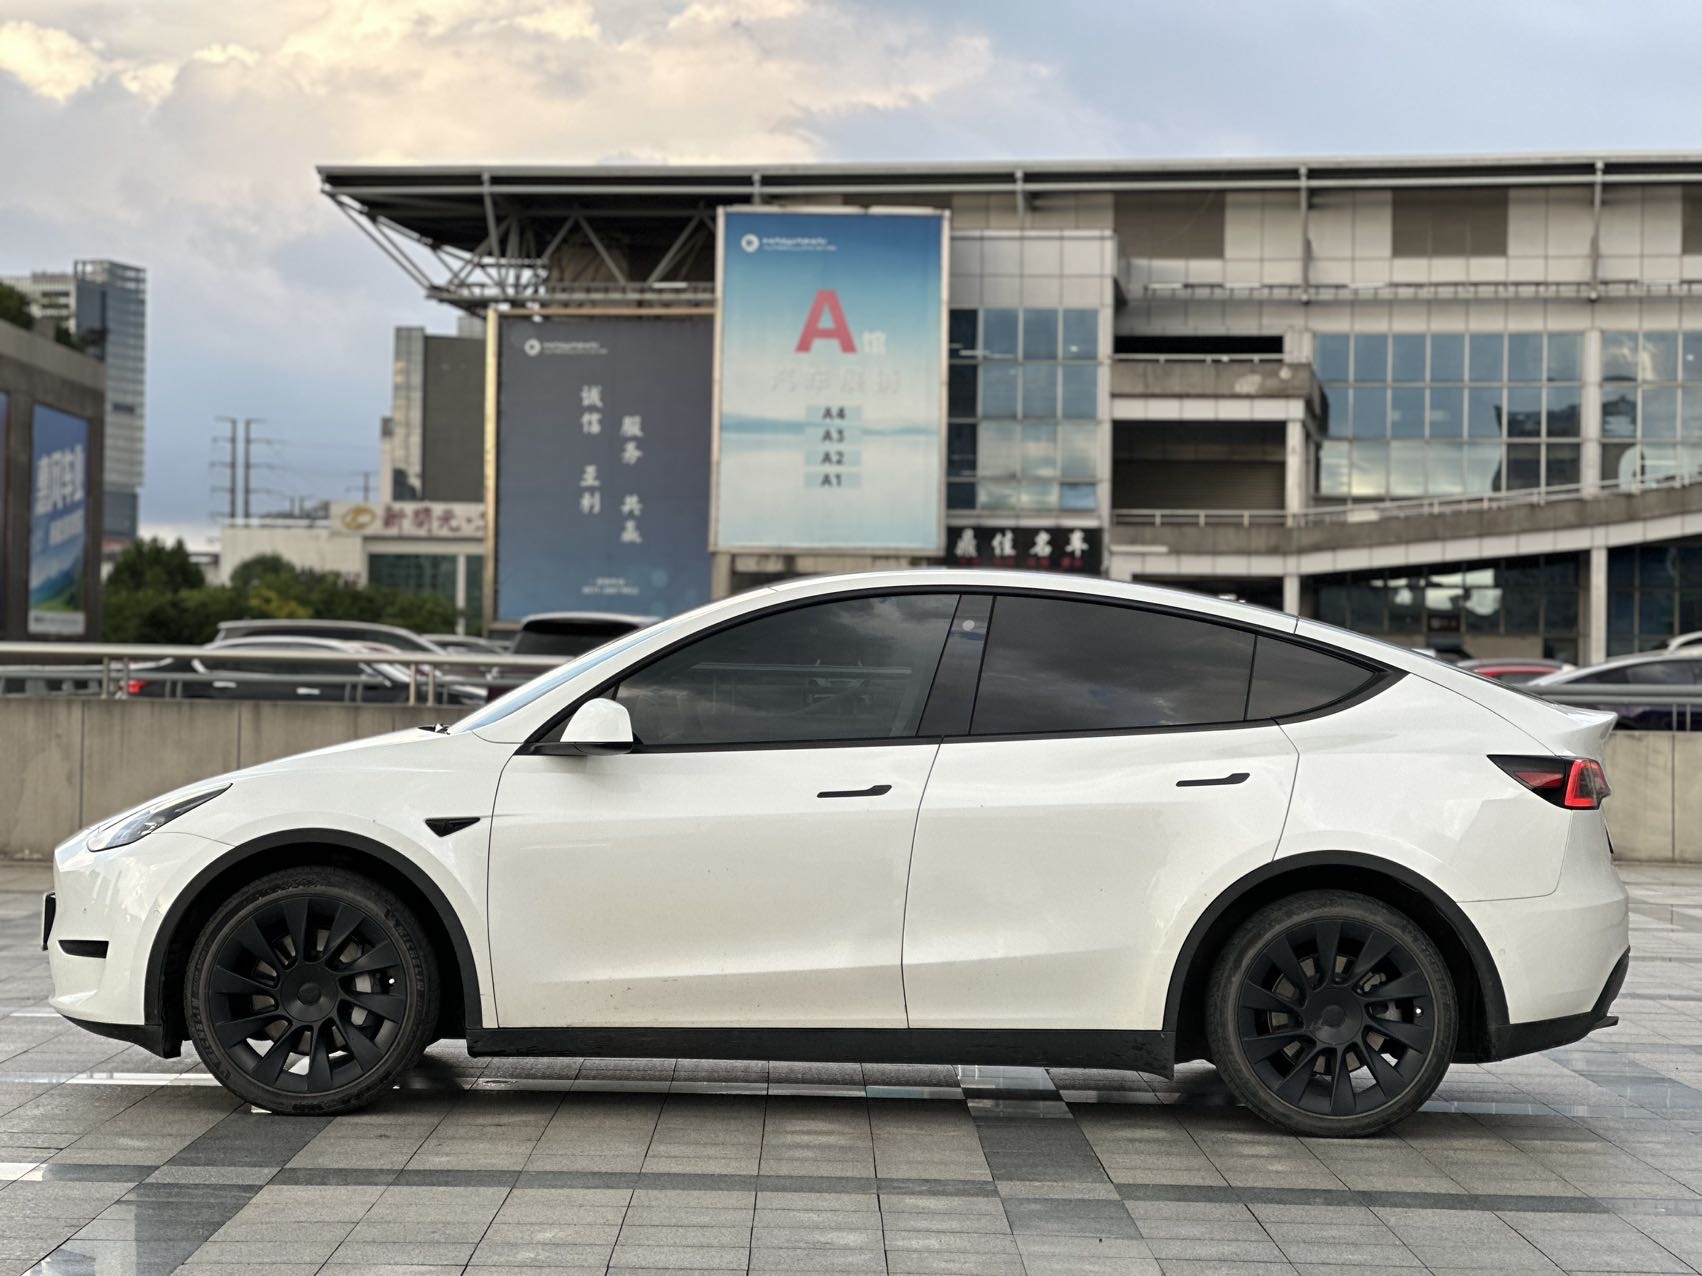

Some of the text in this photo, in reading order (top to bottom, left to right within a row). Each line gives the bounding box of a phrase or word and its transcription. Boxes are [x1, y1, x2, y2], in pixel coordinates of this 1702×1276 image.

[795, 289, 857, 353] A
[822, 406, 846, 420] A4
[822, 428, 845, 443] A3
[820, 450, 845, 466] A2
[820, 473, 842, 488] A1
